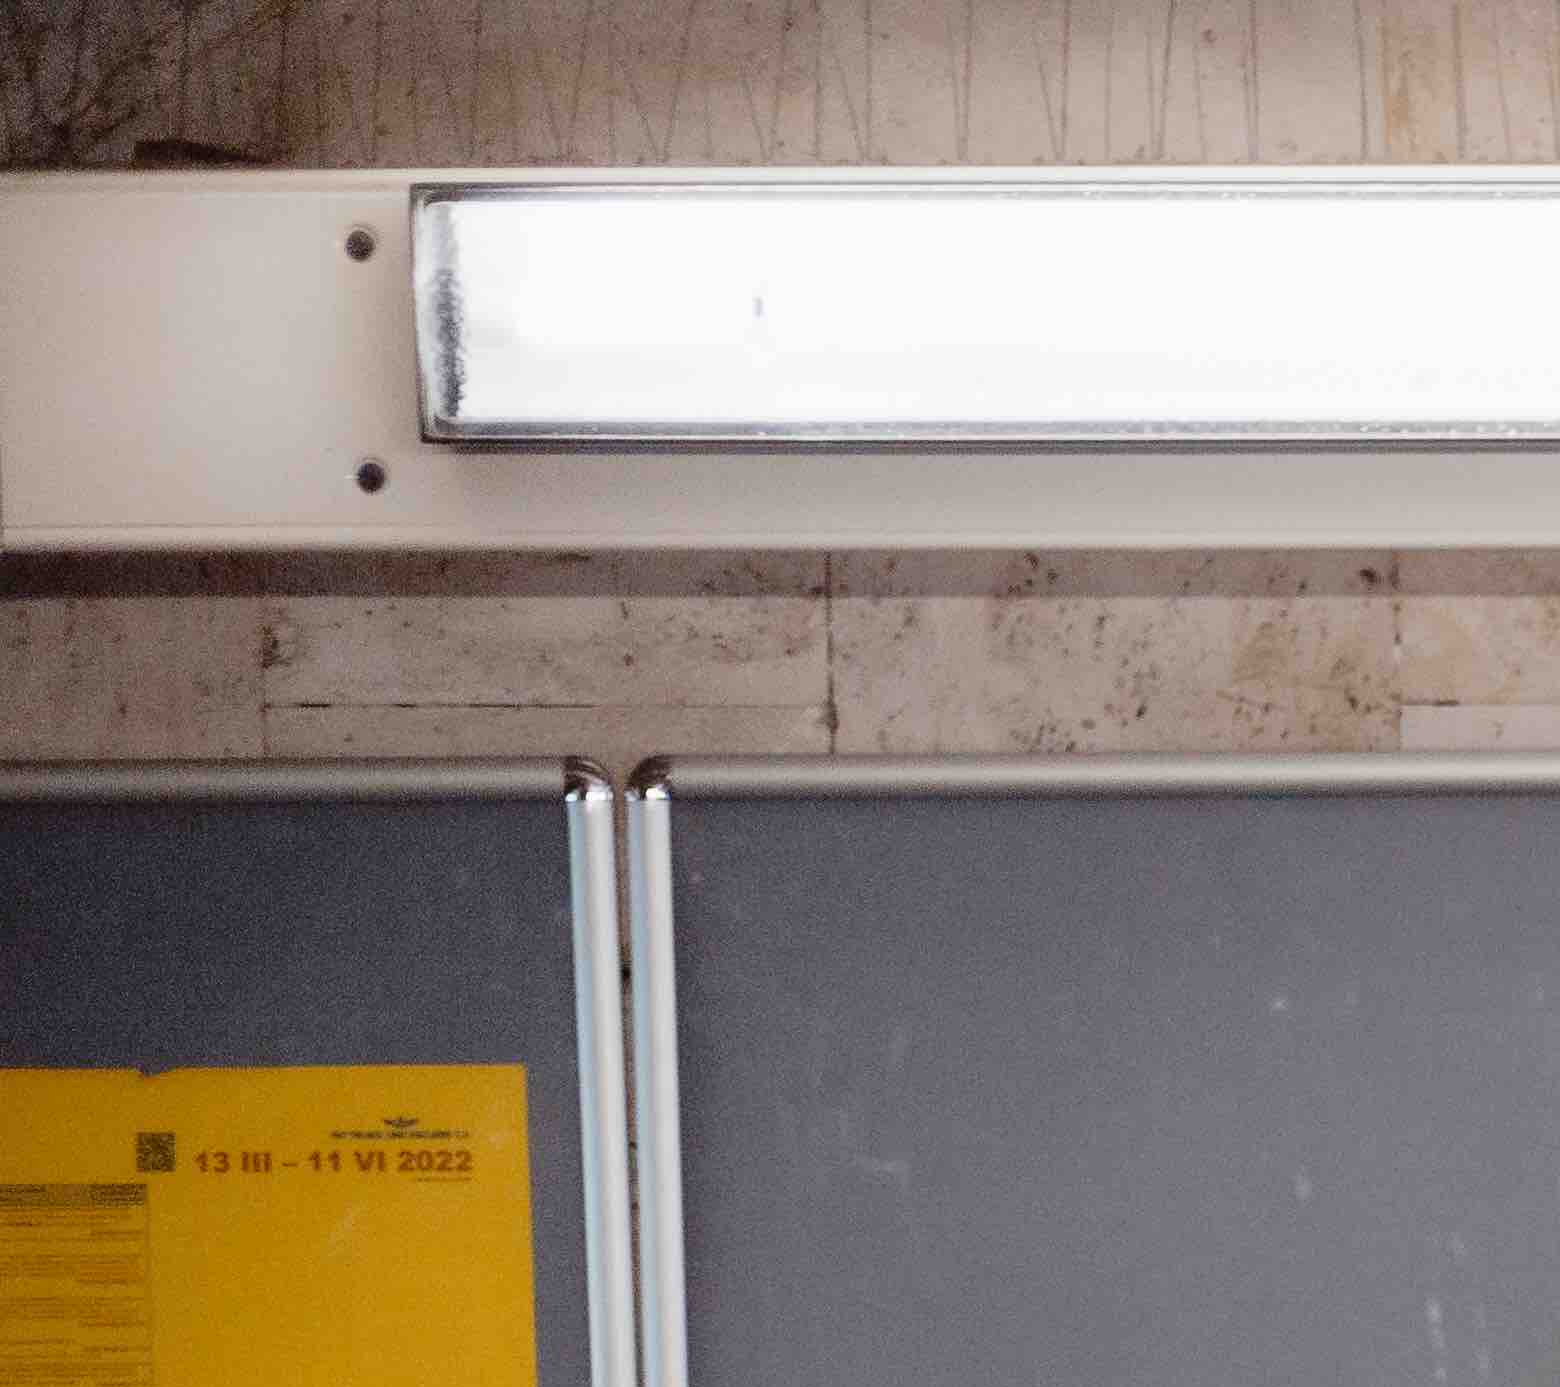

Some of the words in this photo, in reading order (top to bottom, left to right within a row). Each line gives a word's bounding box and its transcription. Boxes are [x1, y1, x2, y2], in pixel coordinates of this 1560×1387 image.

[195, 1151, 230, 1174] 13
[308, 1151, 342, 1173] 11
[354, 1151, 386, 1172] VI
[397, 1150, 473, 1173] 2022
